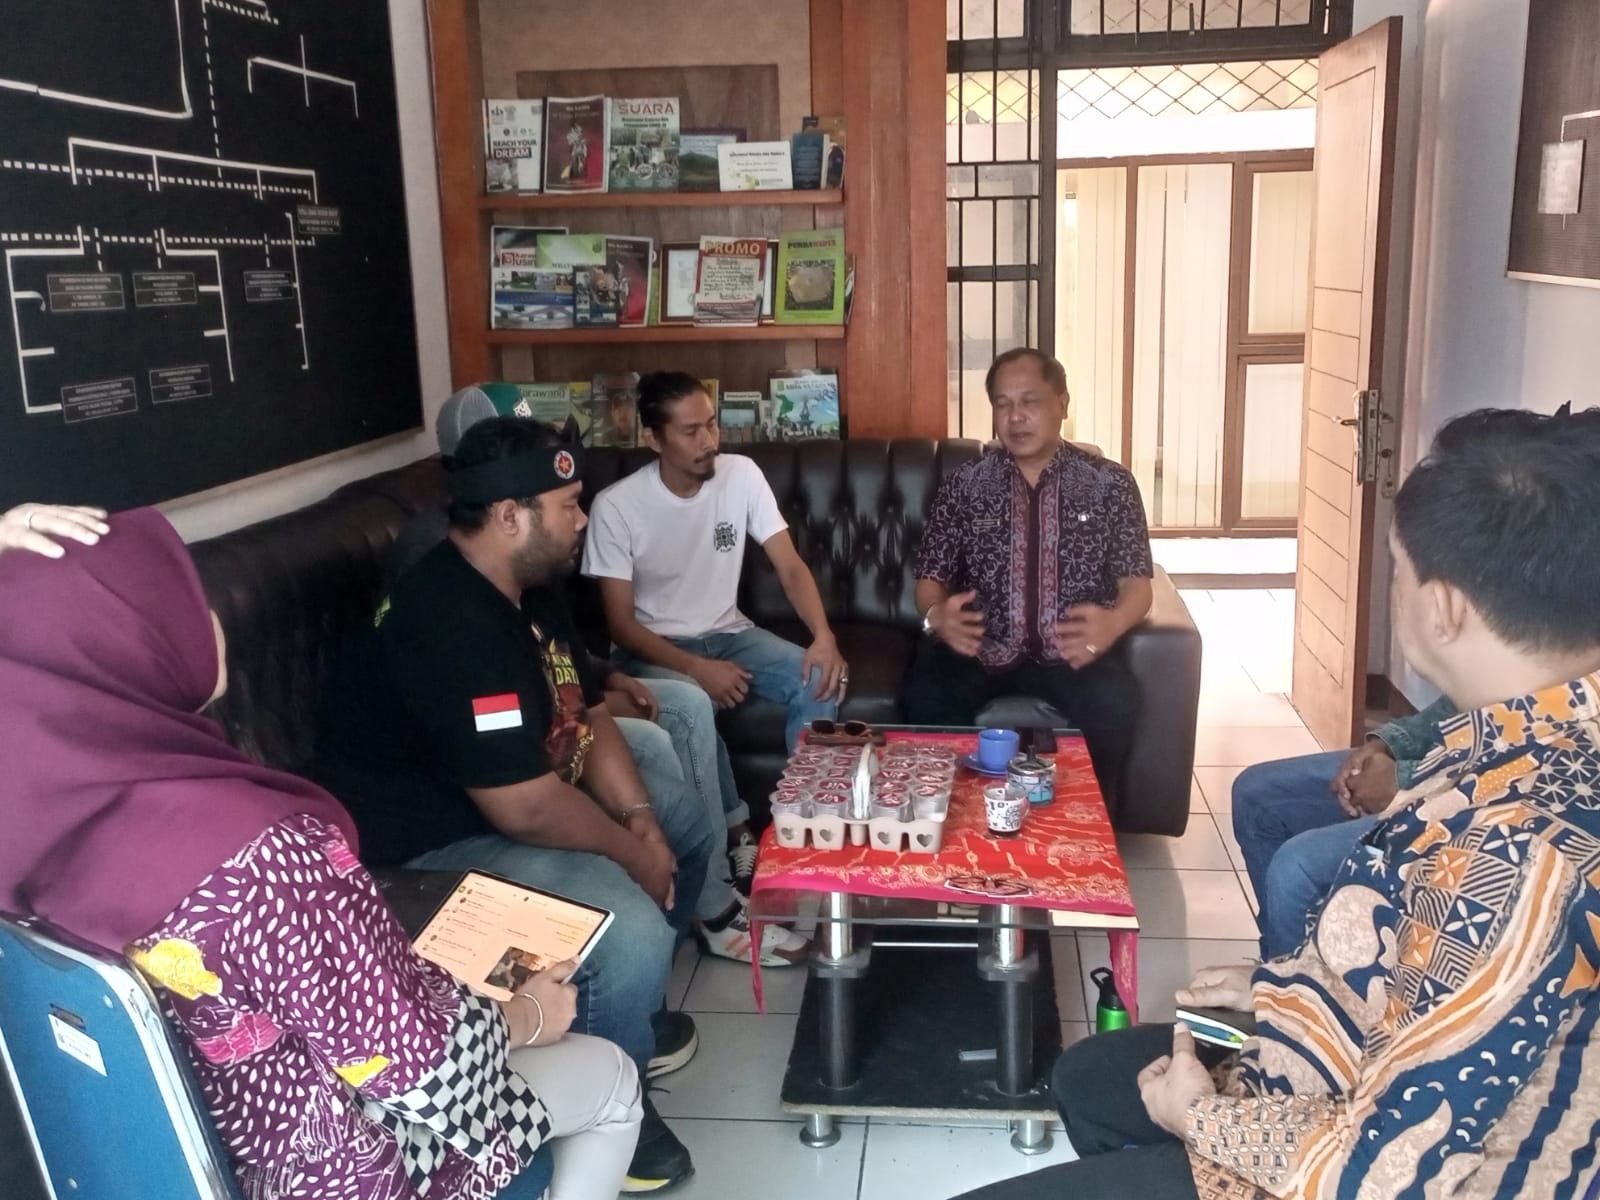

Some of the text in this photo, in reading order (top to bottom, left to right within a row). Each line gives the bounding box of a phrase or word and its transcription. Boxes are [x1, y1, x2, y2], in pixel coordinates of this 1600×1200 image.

[618, 102, 674, 115] SUARA
[495, 148, 530, 158] DREAM
[704, 240, 760, 256] PROMO
